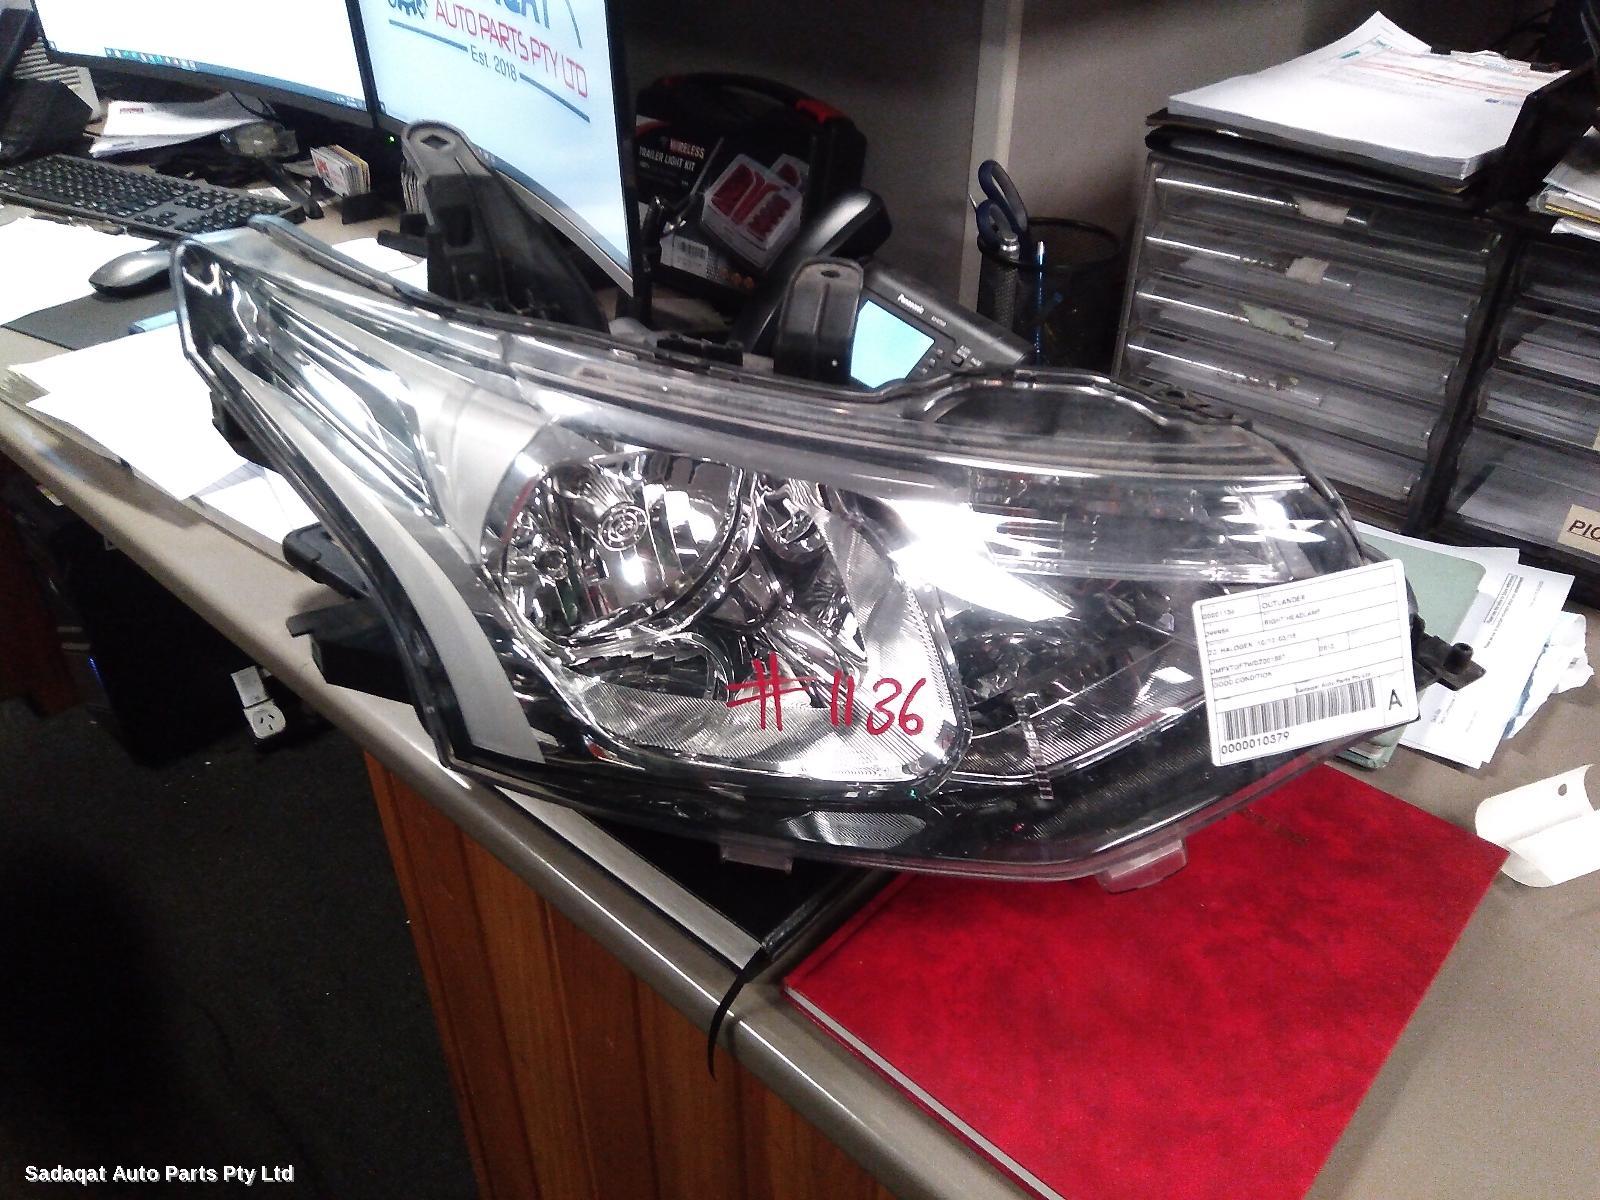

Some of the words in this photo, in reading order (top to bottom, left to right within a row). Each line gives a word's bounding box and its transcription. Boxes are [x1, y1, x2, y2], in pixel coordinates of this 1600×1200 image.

[435, 0, 478, 36] AUTO
[479, 12, 529, 62] PARTS
[530, 36, 558, 79] PTY
[561, 54, 588, 98] LTD
[469, 45, 490, 68] Est.
[494, 55, 518, 82] 2018
[639, 145, 664, 162] TRAILER
[664, 154, 684, 170] LIGHT
[684, 160, 696, 172] KIT
[1262, 594, 1305, 609] OUTLANDER
[1235, 671, 1272, 685] CONDITION
[1388, 689, 1402, 710] A
[1221, 731, 1290, 755] 0000010379
